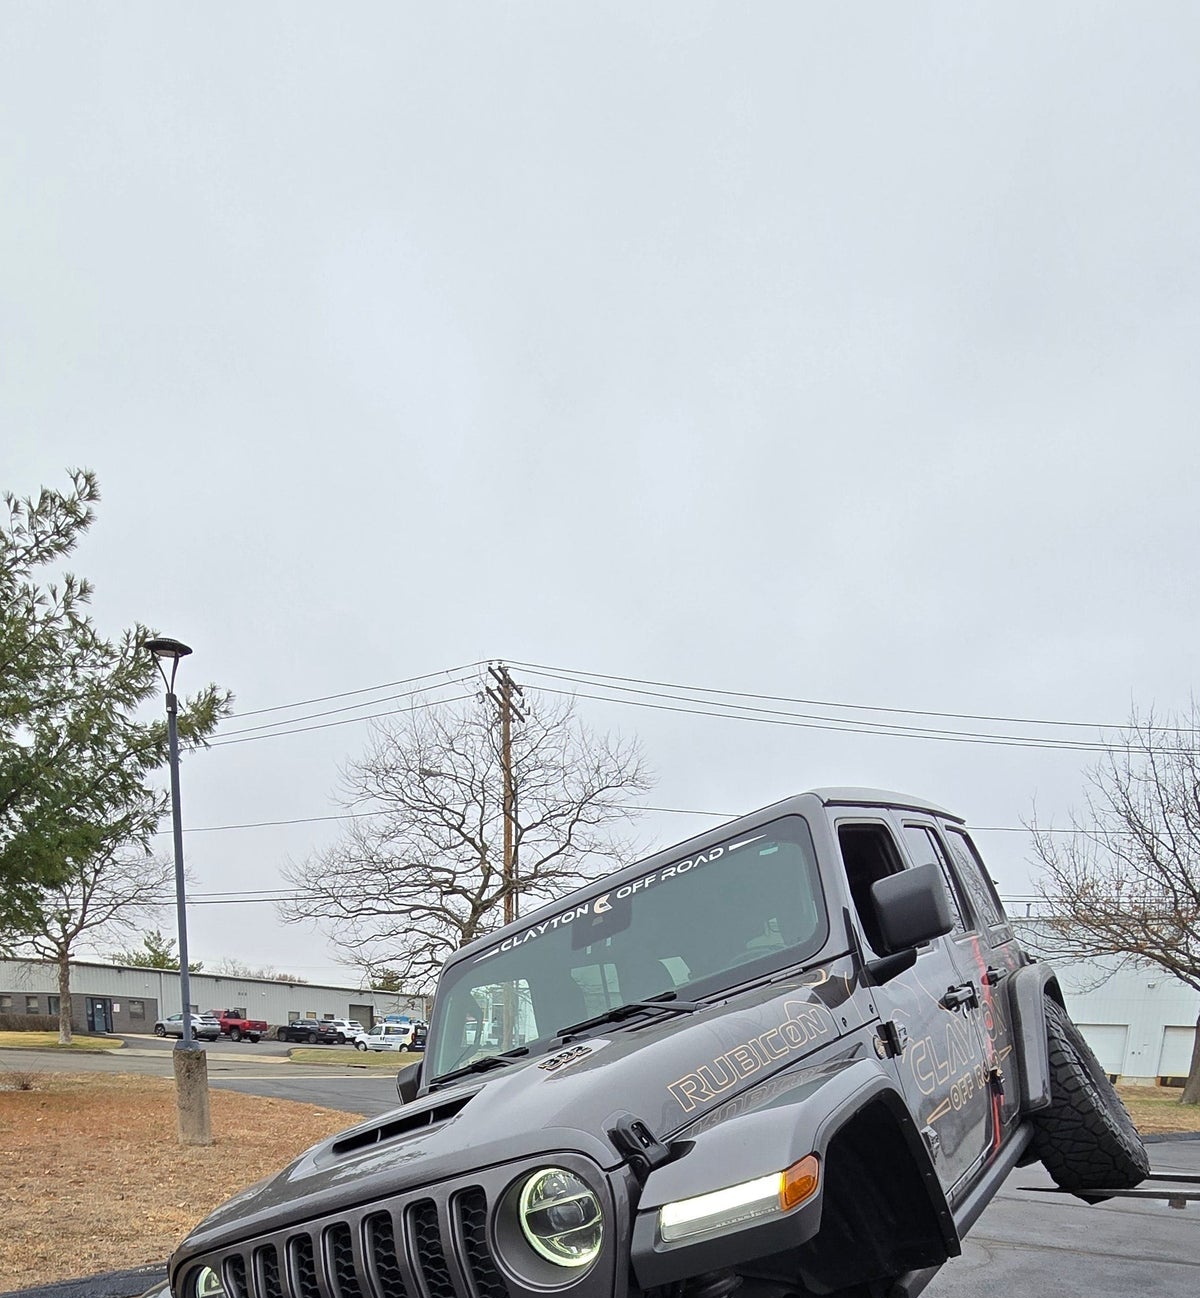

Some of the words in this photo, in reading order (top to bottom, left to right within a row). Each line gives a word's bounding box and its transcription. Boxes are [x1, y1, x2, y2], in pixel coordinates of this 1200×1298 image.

[500, 904, 589, 951] CLAYTON
[616, 874, 657, 899] OFF
[661, 847, 724, 881] ROAD
[667, 1008, 828, 1112] RUBICON
[950, 1072, 974, 1111] OFF
